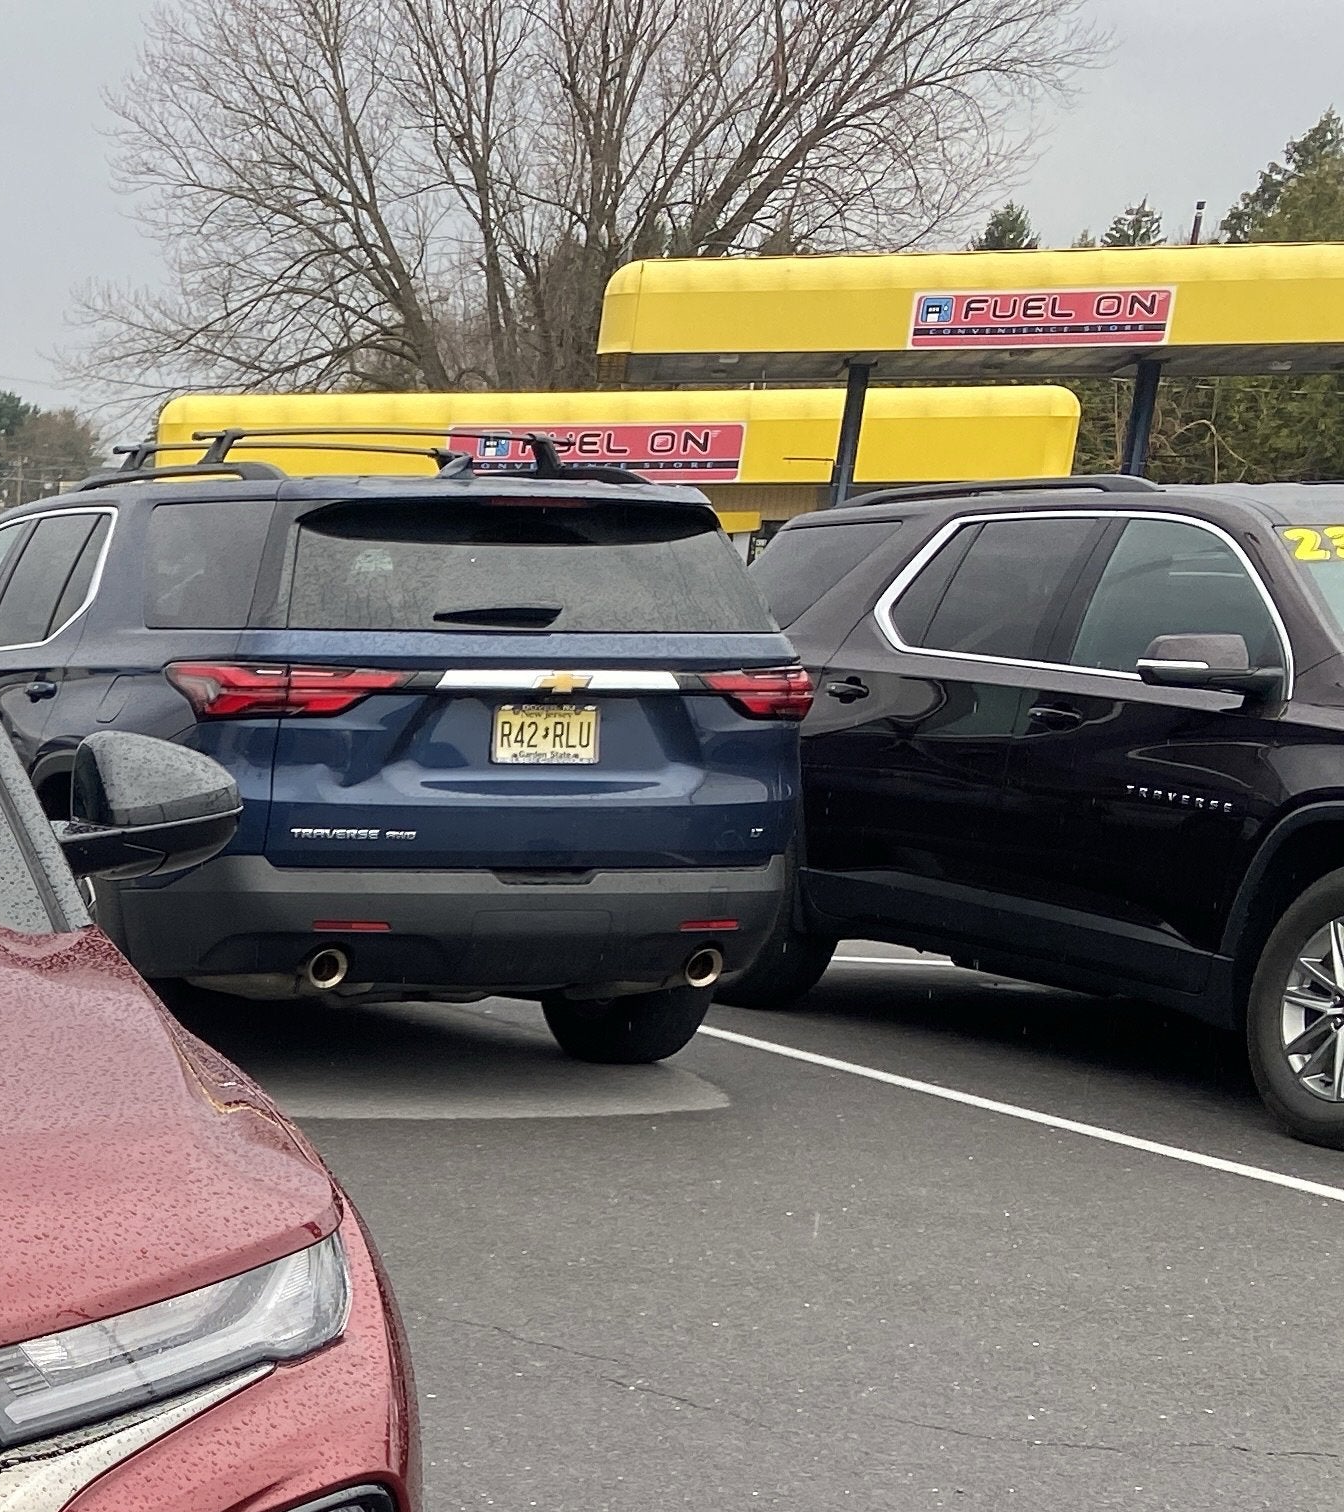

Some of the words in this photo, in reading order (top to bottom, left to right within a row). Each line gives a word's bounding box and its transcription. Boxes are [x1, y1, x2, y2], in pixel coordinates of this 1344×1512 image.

[963, 296, 1073, 320] FUEL
[1095, 294, 1159, 317] ON
[1083, 324, 1145, 332] STORE
[649, 431, 710, 454] ON
[519, 751, 547, 759] Garden
[550, 751, 573, 759] State
[1126, 785, 1233, 812] TRAVERSE
[291, 828, 379, 840] TRAVERSE
